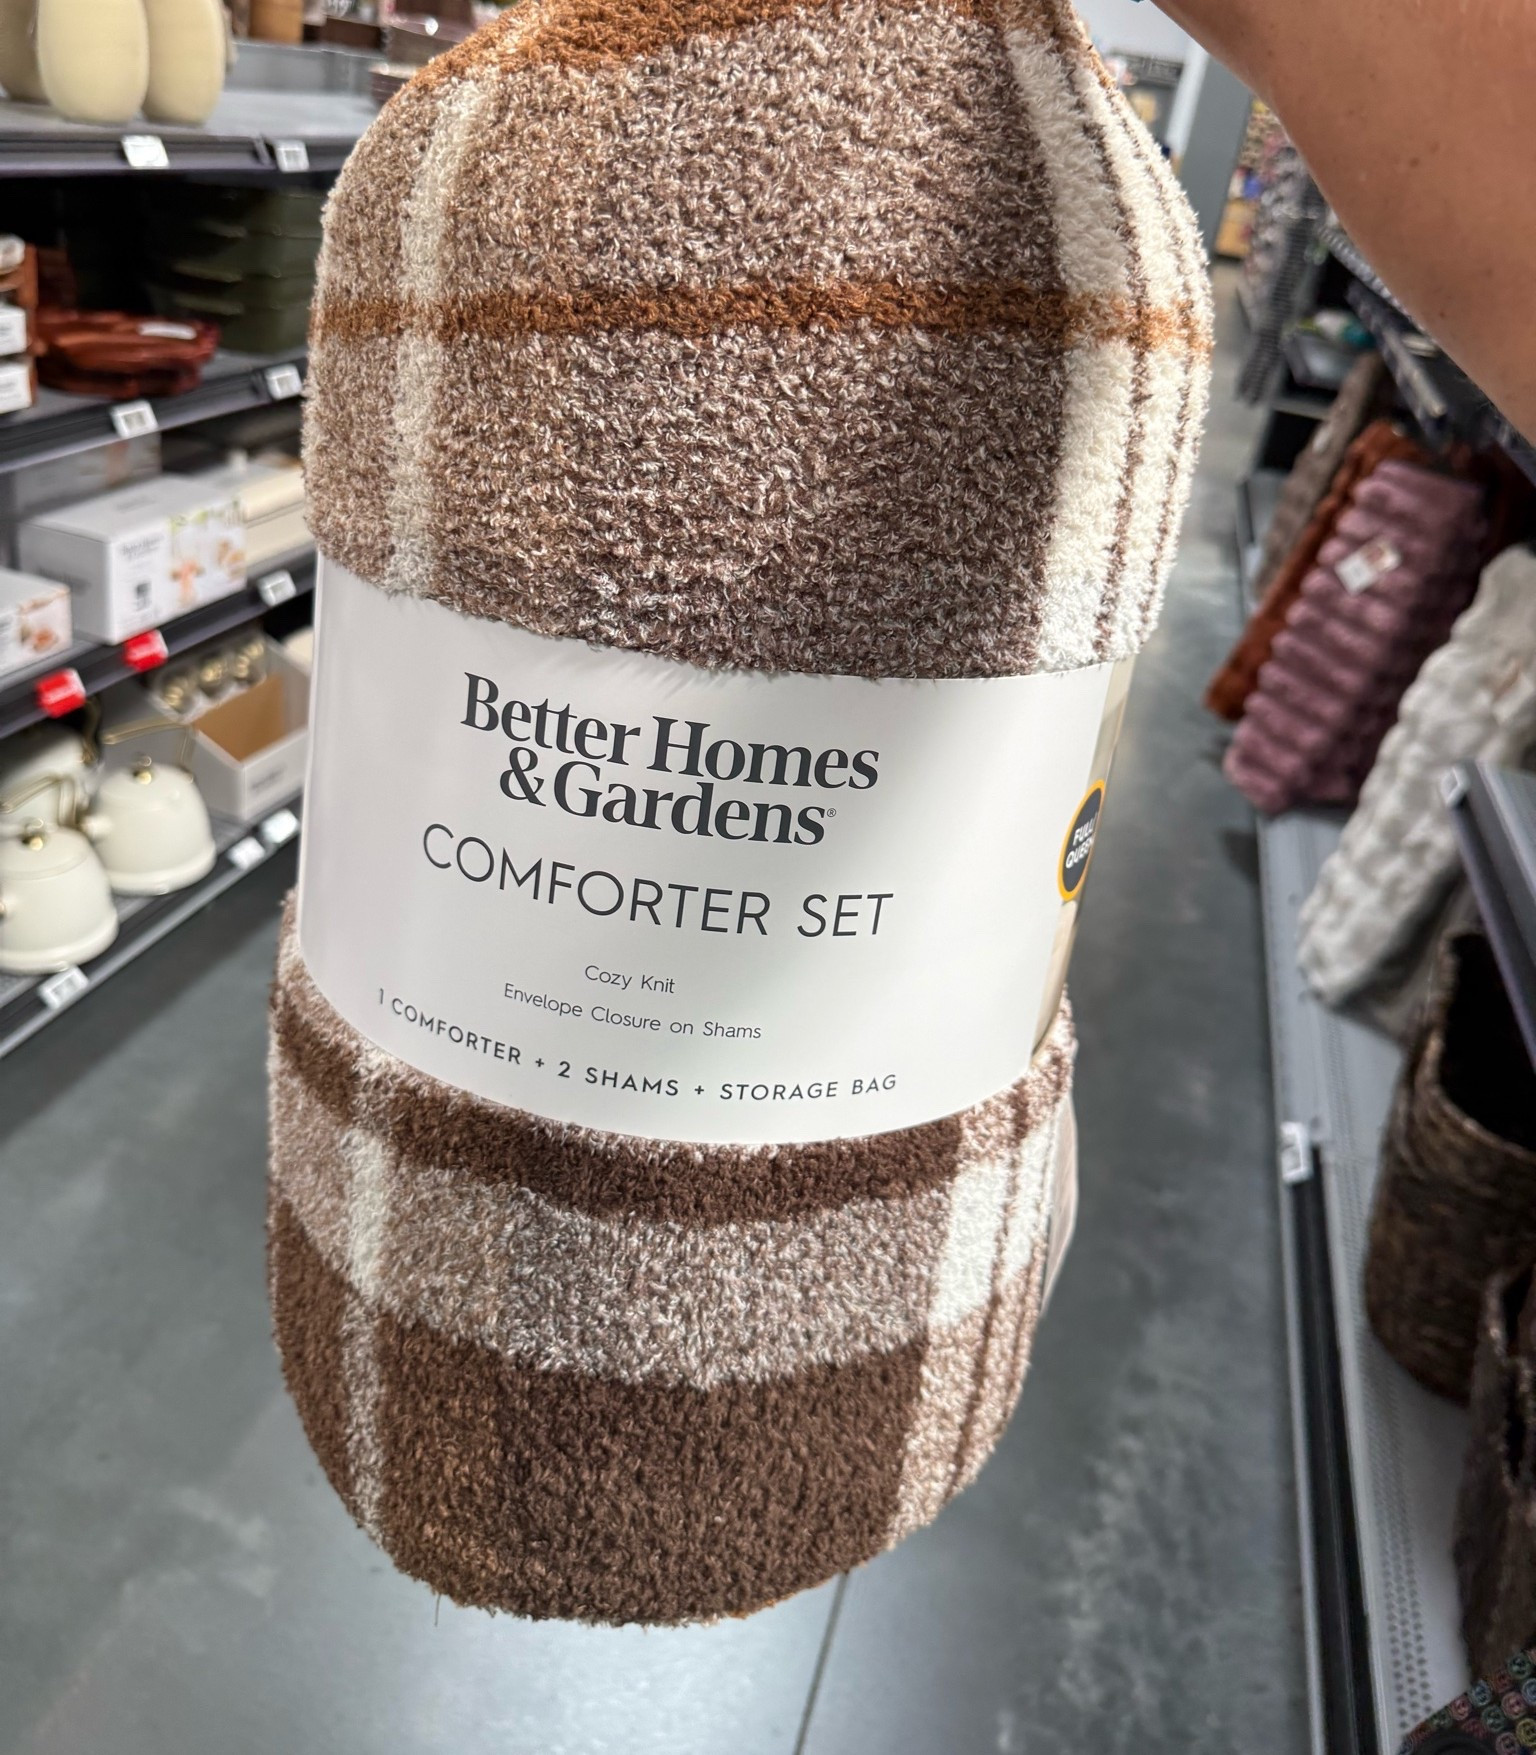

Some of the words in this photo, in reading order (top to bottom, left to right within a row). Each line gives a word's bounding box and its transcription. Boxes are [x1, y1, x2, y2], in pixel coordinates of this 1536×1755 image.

[460, 672, 641, 766] Better
[647, 716, 880, 790] Homes
[423, 823, 771, 936] COMFORTER
[797, 893, 895, 938] SET
[504, 983, 583, 1018] Envelope
[591, 1006, 661, 1032] Closure
[670, 1021, 694, 1035] on
[703, 1021, 762, 1039] Shams
[585, 965, 633, 990] Cozy
[641, 974, 676, 994] Knit
[378, 988, 385, 1005] 1
[391, 997, 522, 1065] COMFORTER
[535, 1057, 545, 1068] +
[558, 1061, 571, 1079] 2
[585, 1067, 679, 1097] SHAMS
[694, 1085, 705, 1096] +
[720, 1081, 839, 1101] STORAGE
[851, 1074, 897, 1096] BAG
